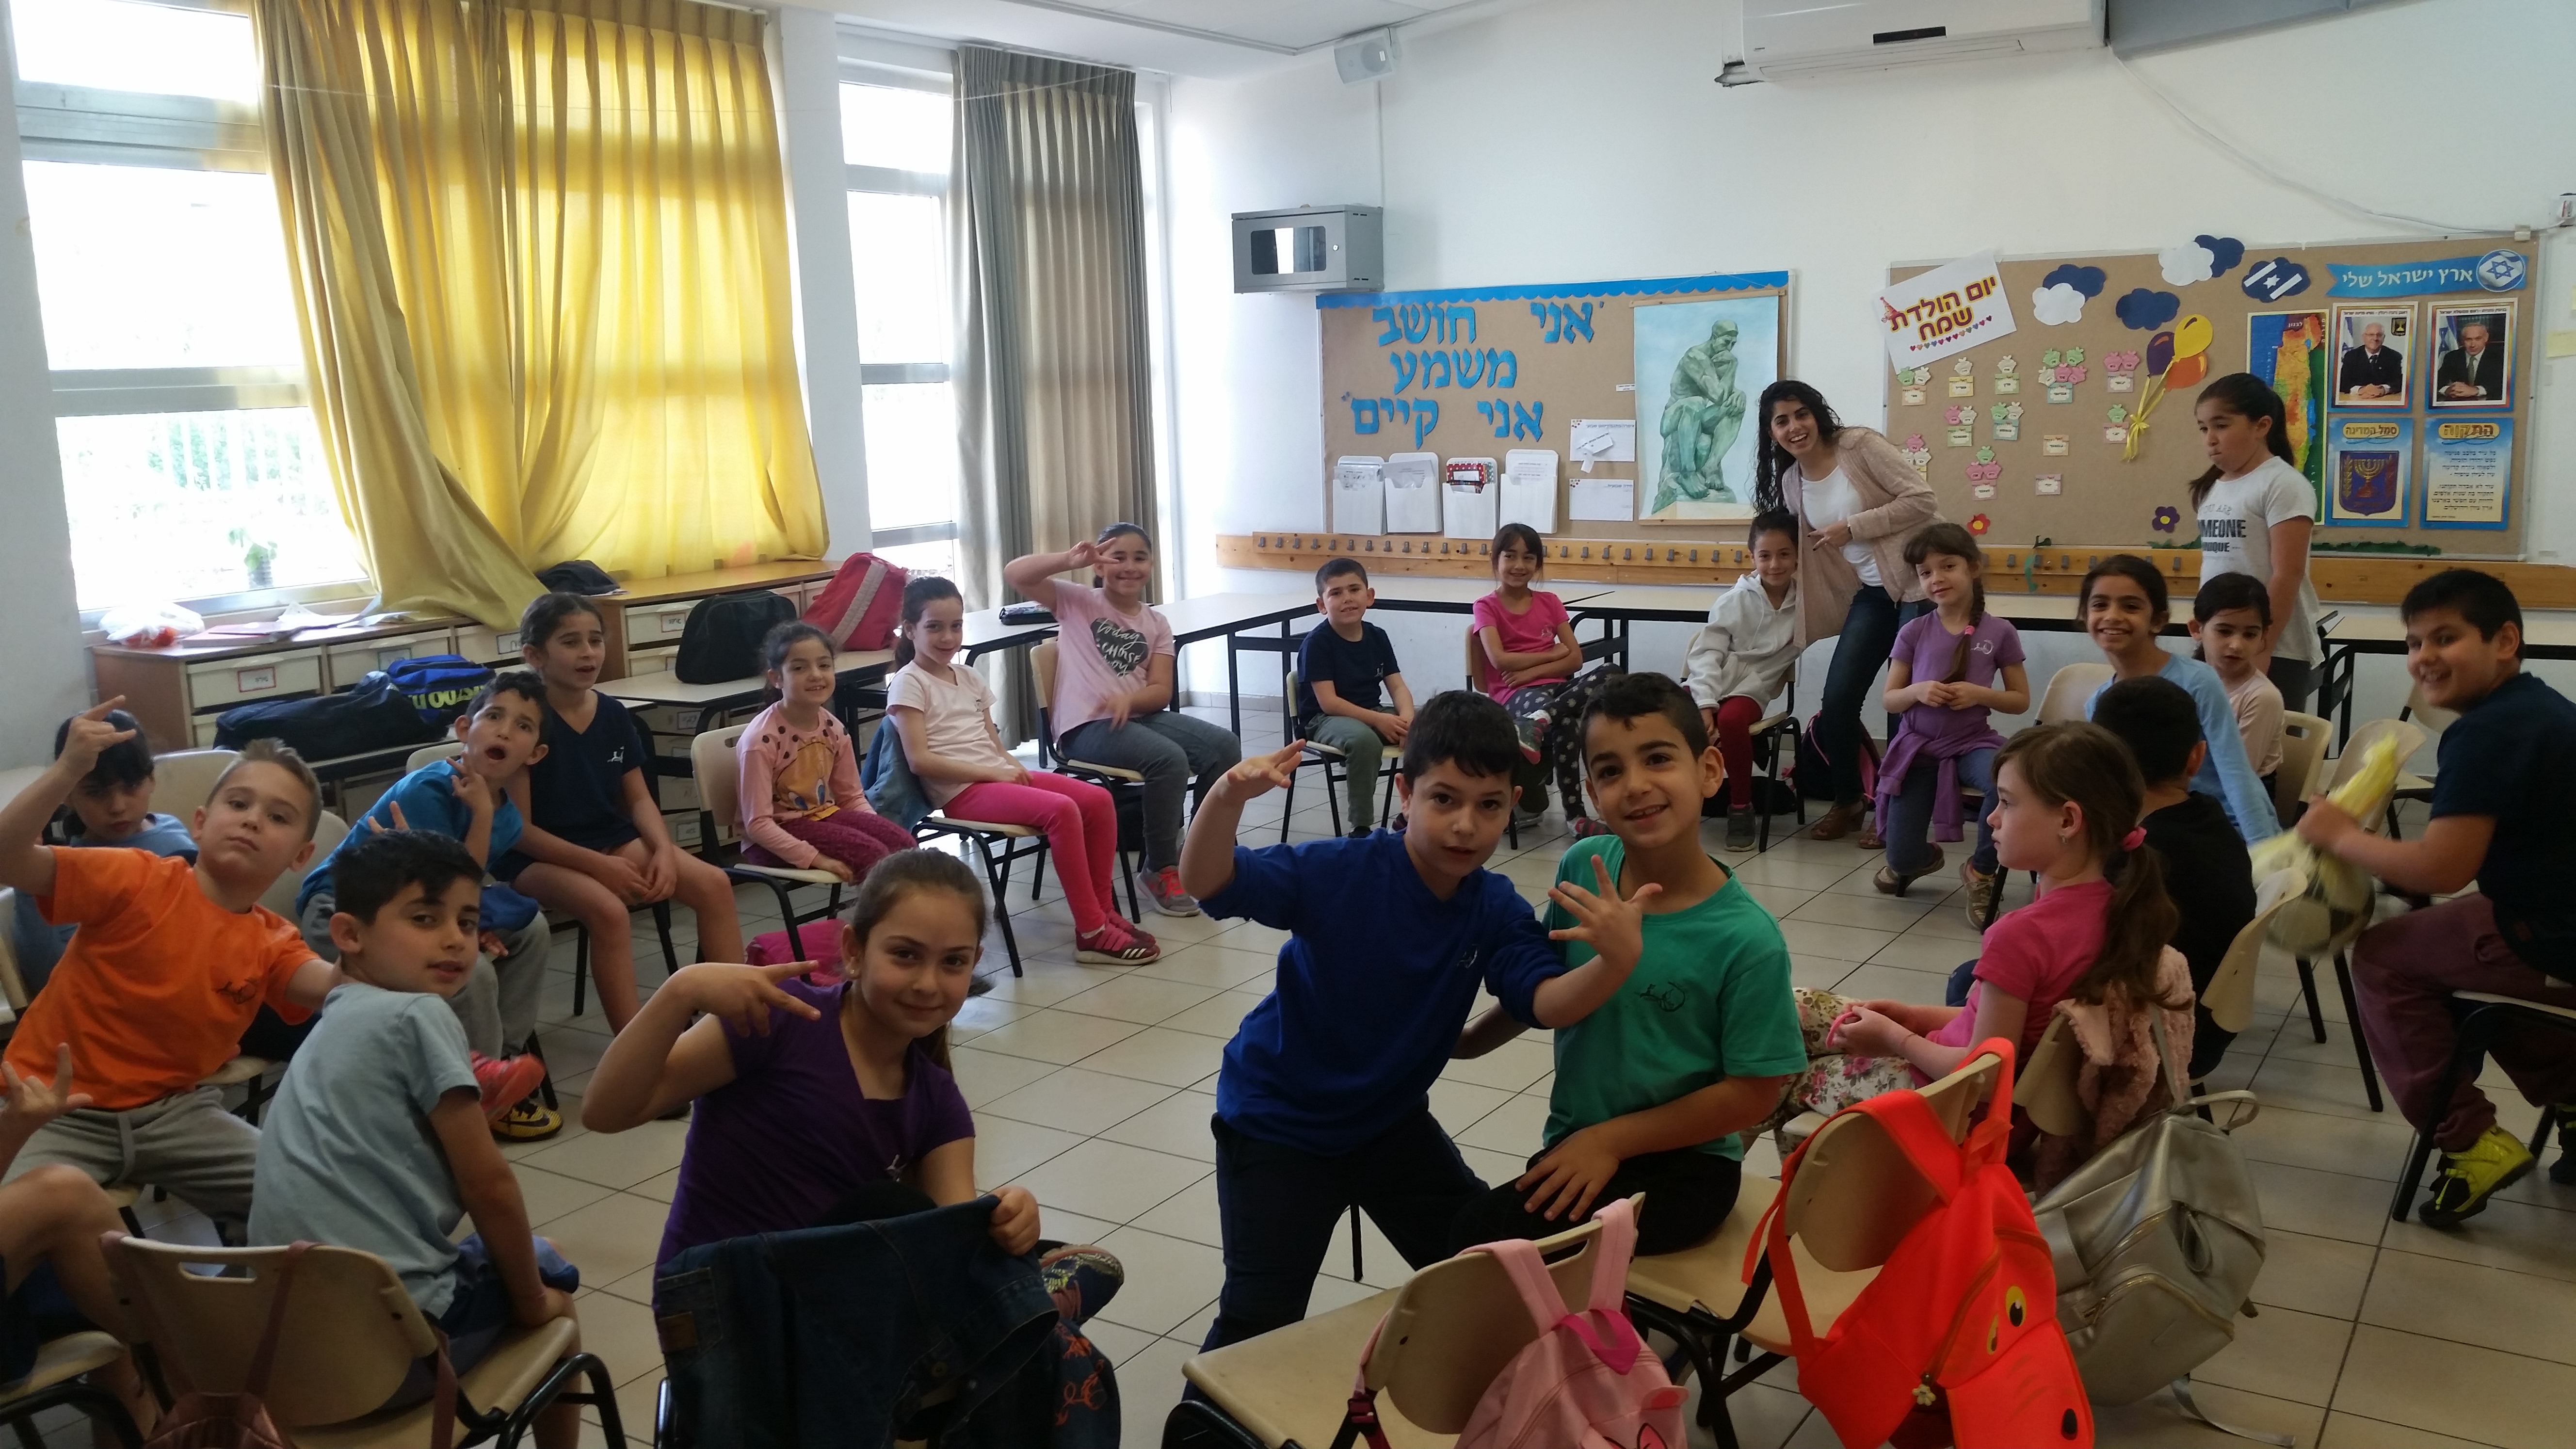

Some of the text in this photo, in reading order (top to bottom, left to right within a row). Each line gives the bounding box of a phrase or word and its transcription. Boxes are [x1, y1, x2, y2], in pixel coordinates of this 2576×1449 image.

[2342, 268, 2473, 288] ארץ ישראל שלי
[1891, 276, 1996, 331] יום הולדת
[1372, 304, 1476, 346] חושב
[1919, 307, 1972, 340] שמח
[1390, 348, 1517, 395] משמע
[1477, 399, 1543, 442] אני
[2345, 424, 2397, 436] סמל המדינה
[2444, 424, 2494, 438] התקוה
[2198, 519, 2247, 538] MEONE
[1096, 618, 1148, 650] today
